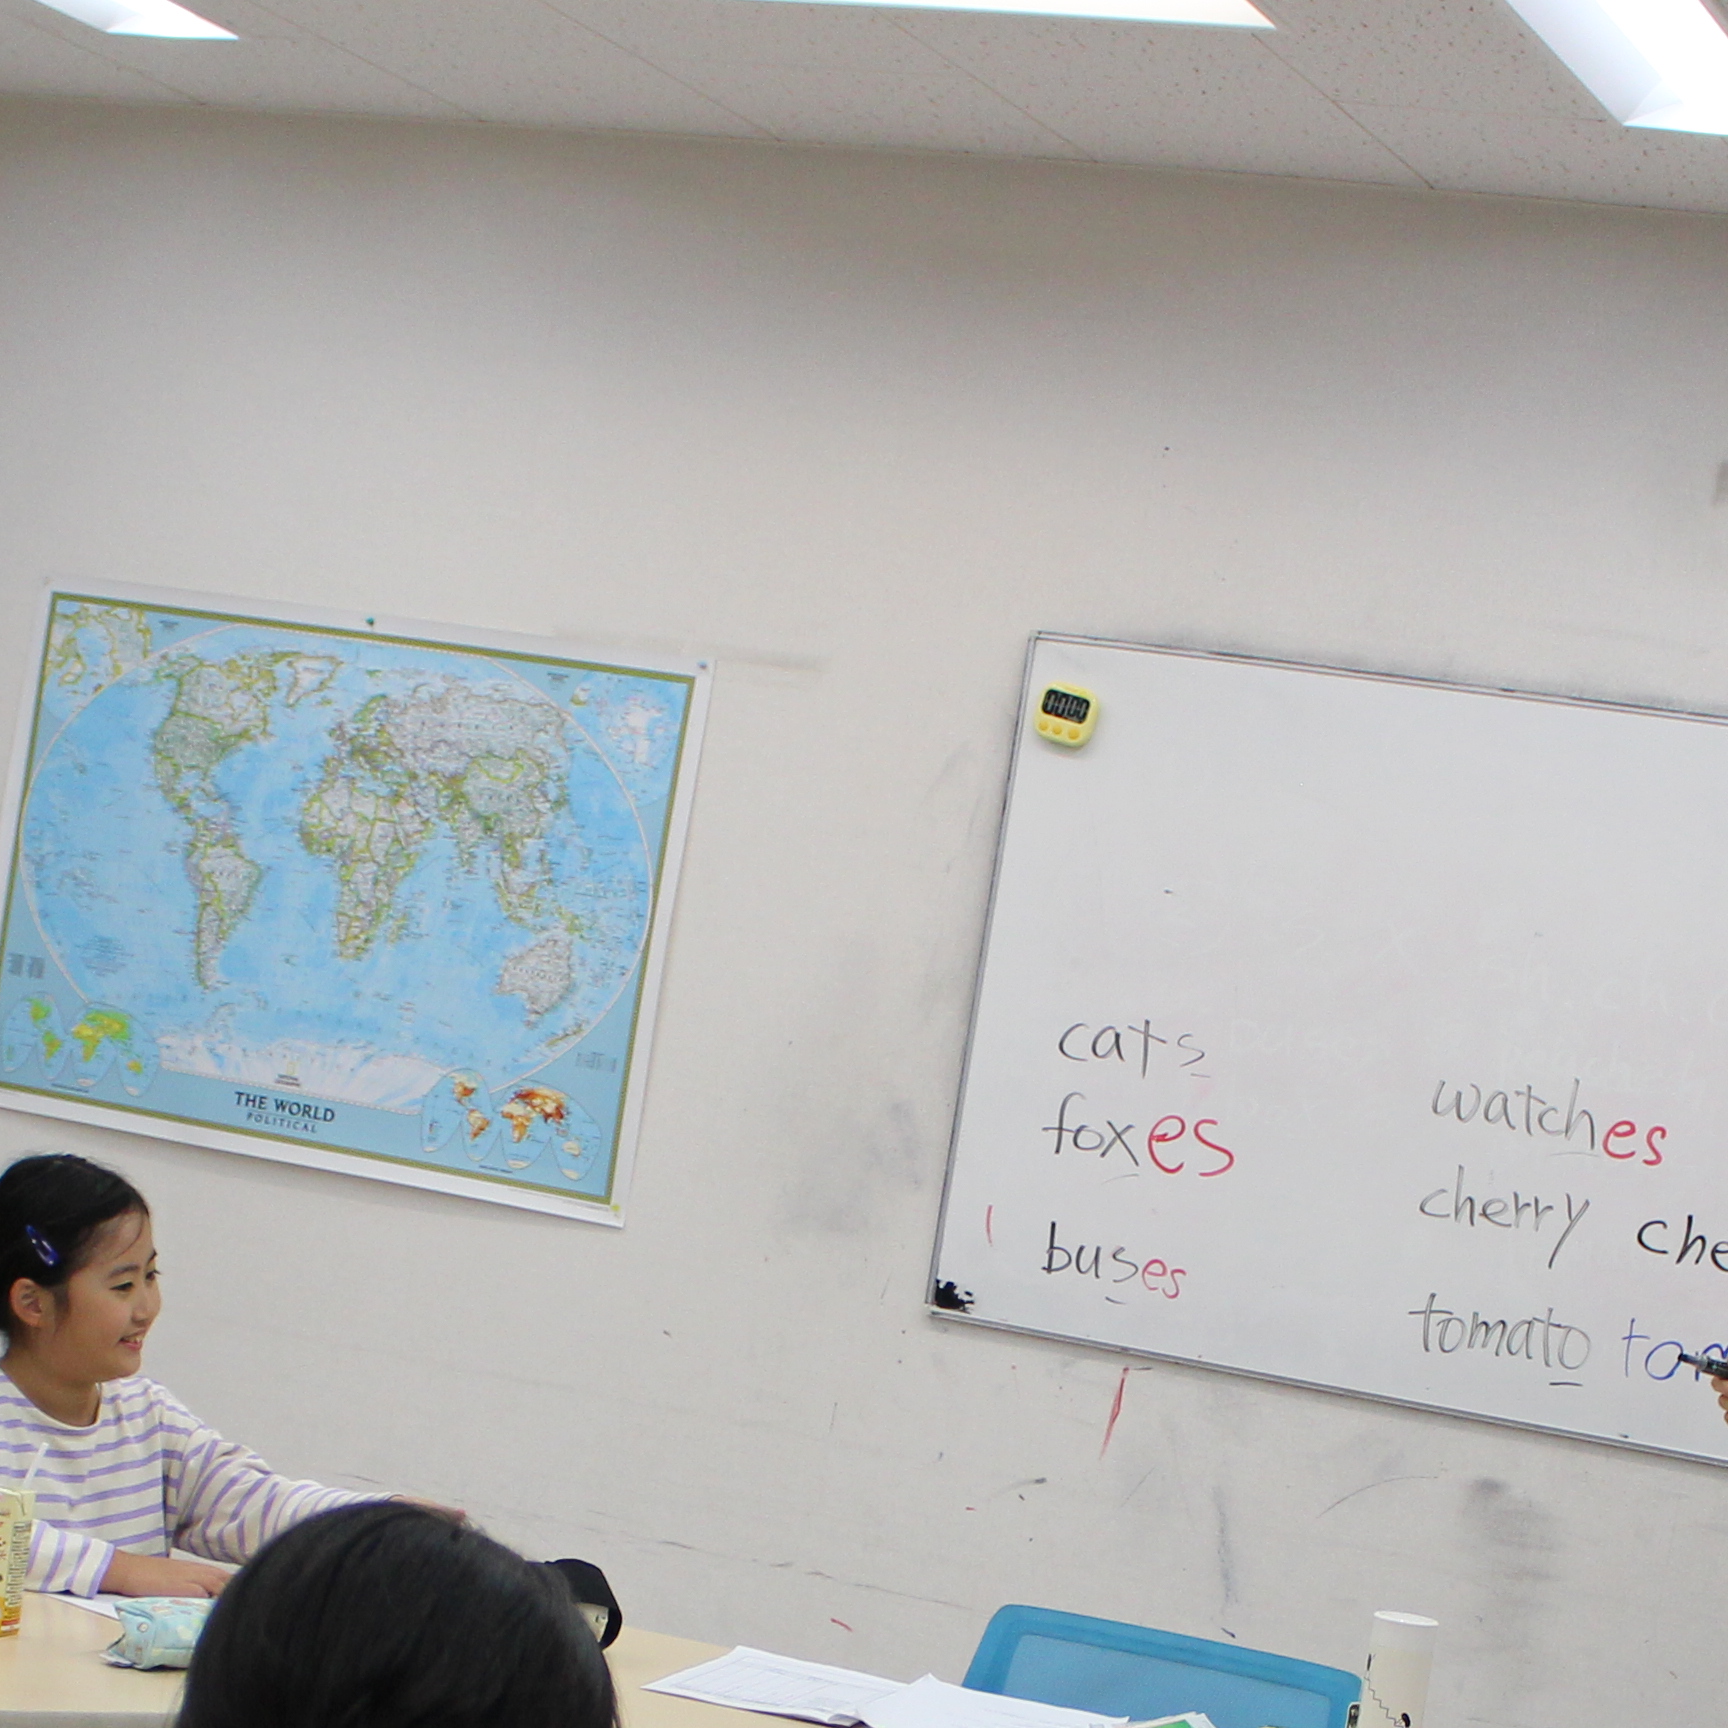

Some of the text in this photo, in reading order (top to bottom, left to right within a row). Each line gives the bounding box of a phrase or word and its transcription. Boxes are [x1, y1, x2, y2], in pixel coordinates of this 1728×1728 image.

[1058, 1019, 1206, 1079] cats
[234, 1091, 335, 1122] THE WORLD
[246, 1112, 318, 1134] POLITICAL
[1041, 1091, 1235, 1177] foxes
[1431, 1077, 1668, 1166] watches
[1419, 1164, 1590, 1269] cherry
[1041, 1221, 1187, 1299] buses
[1408, 1292, 1592, 1370] tomato
